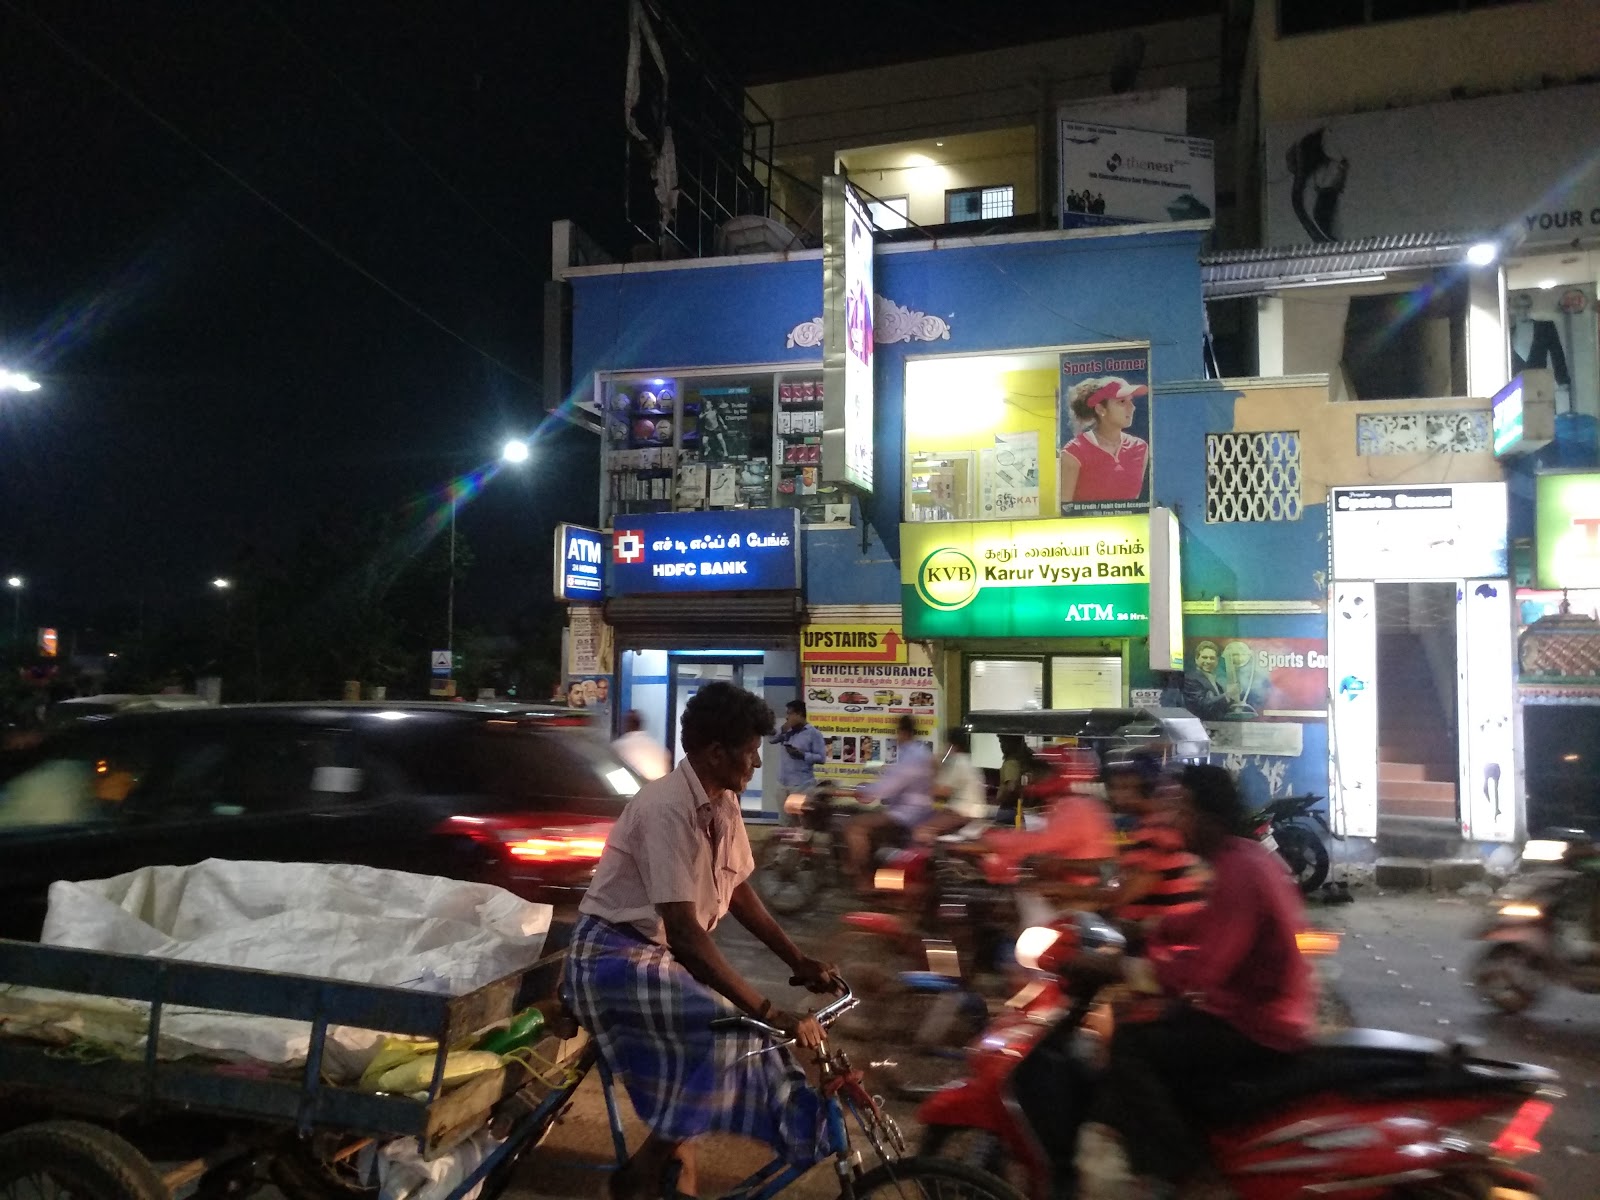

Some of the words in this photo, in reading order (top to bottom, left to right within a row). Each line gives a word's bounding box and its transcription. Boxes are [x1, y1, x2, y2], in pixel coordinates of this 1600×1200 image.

[1526, 209, 1583, 232] YOUR
[1063, 360, 1101, 376] Sports
[1105, 358, 1145, 372] Corner
[567, 537, 602, 564] ATM
[652, 536, 673, 551] எச்
[746, 532, 790, 548] பேங்க்
[984, 543, 1018, 562] கரூர்
[1024, 541, 1090, 558] வைஸ்யா
[1096, 538, 1145, 556] பேங்க்
[653, 562, 697, 577] HDFC
[700, 560, 748, 576] BANK
[927, 566, 972, 583] KVB
[984, 565, 1034, 581] Karur
[1039, 563, 1092, 583] Vysya
[1097, 561, 1146, 578] Bank
[1064, 603, 1115, 622] ATM
[803, 631, 878, 649] UPSTAIRS
[811, 664, 860, 676] VEHICLE
[863, 665, 934, 677] INSURANCE
[1258, 650, 1304, 672] Sports
